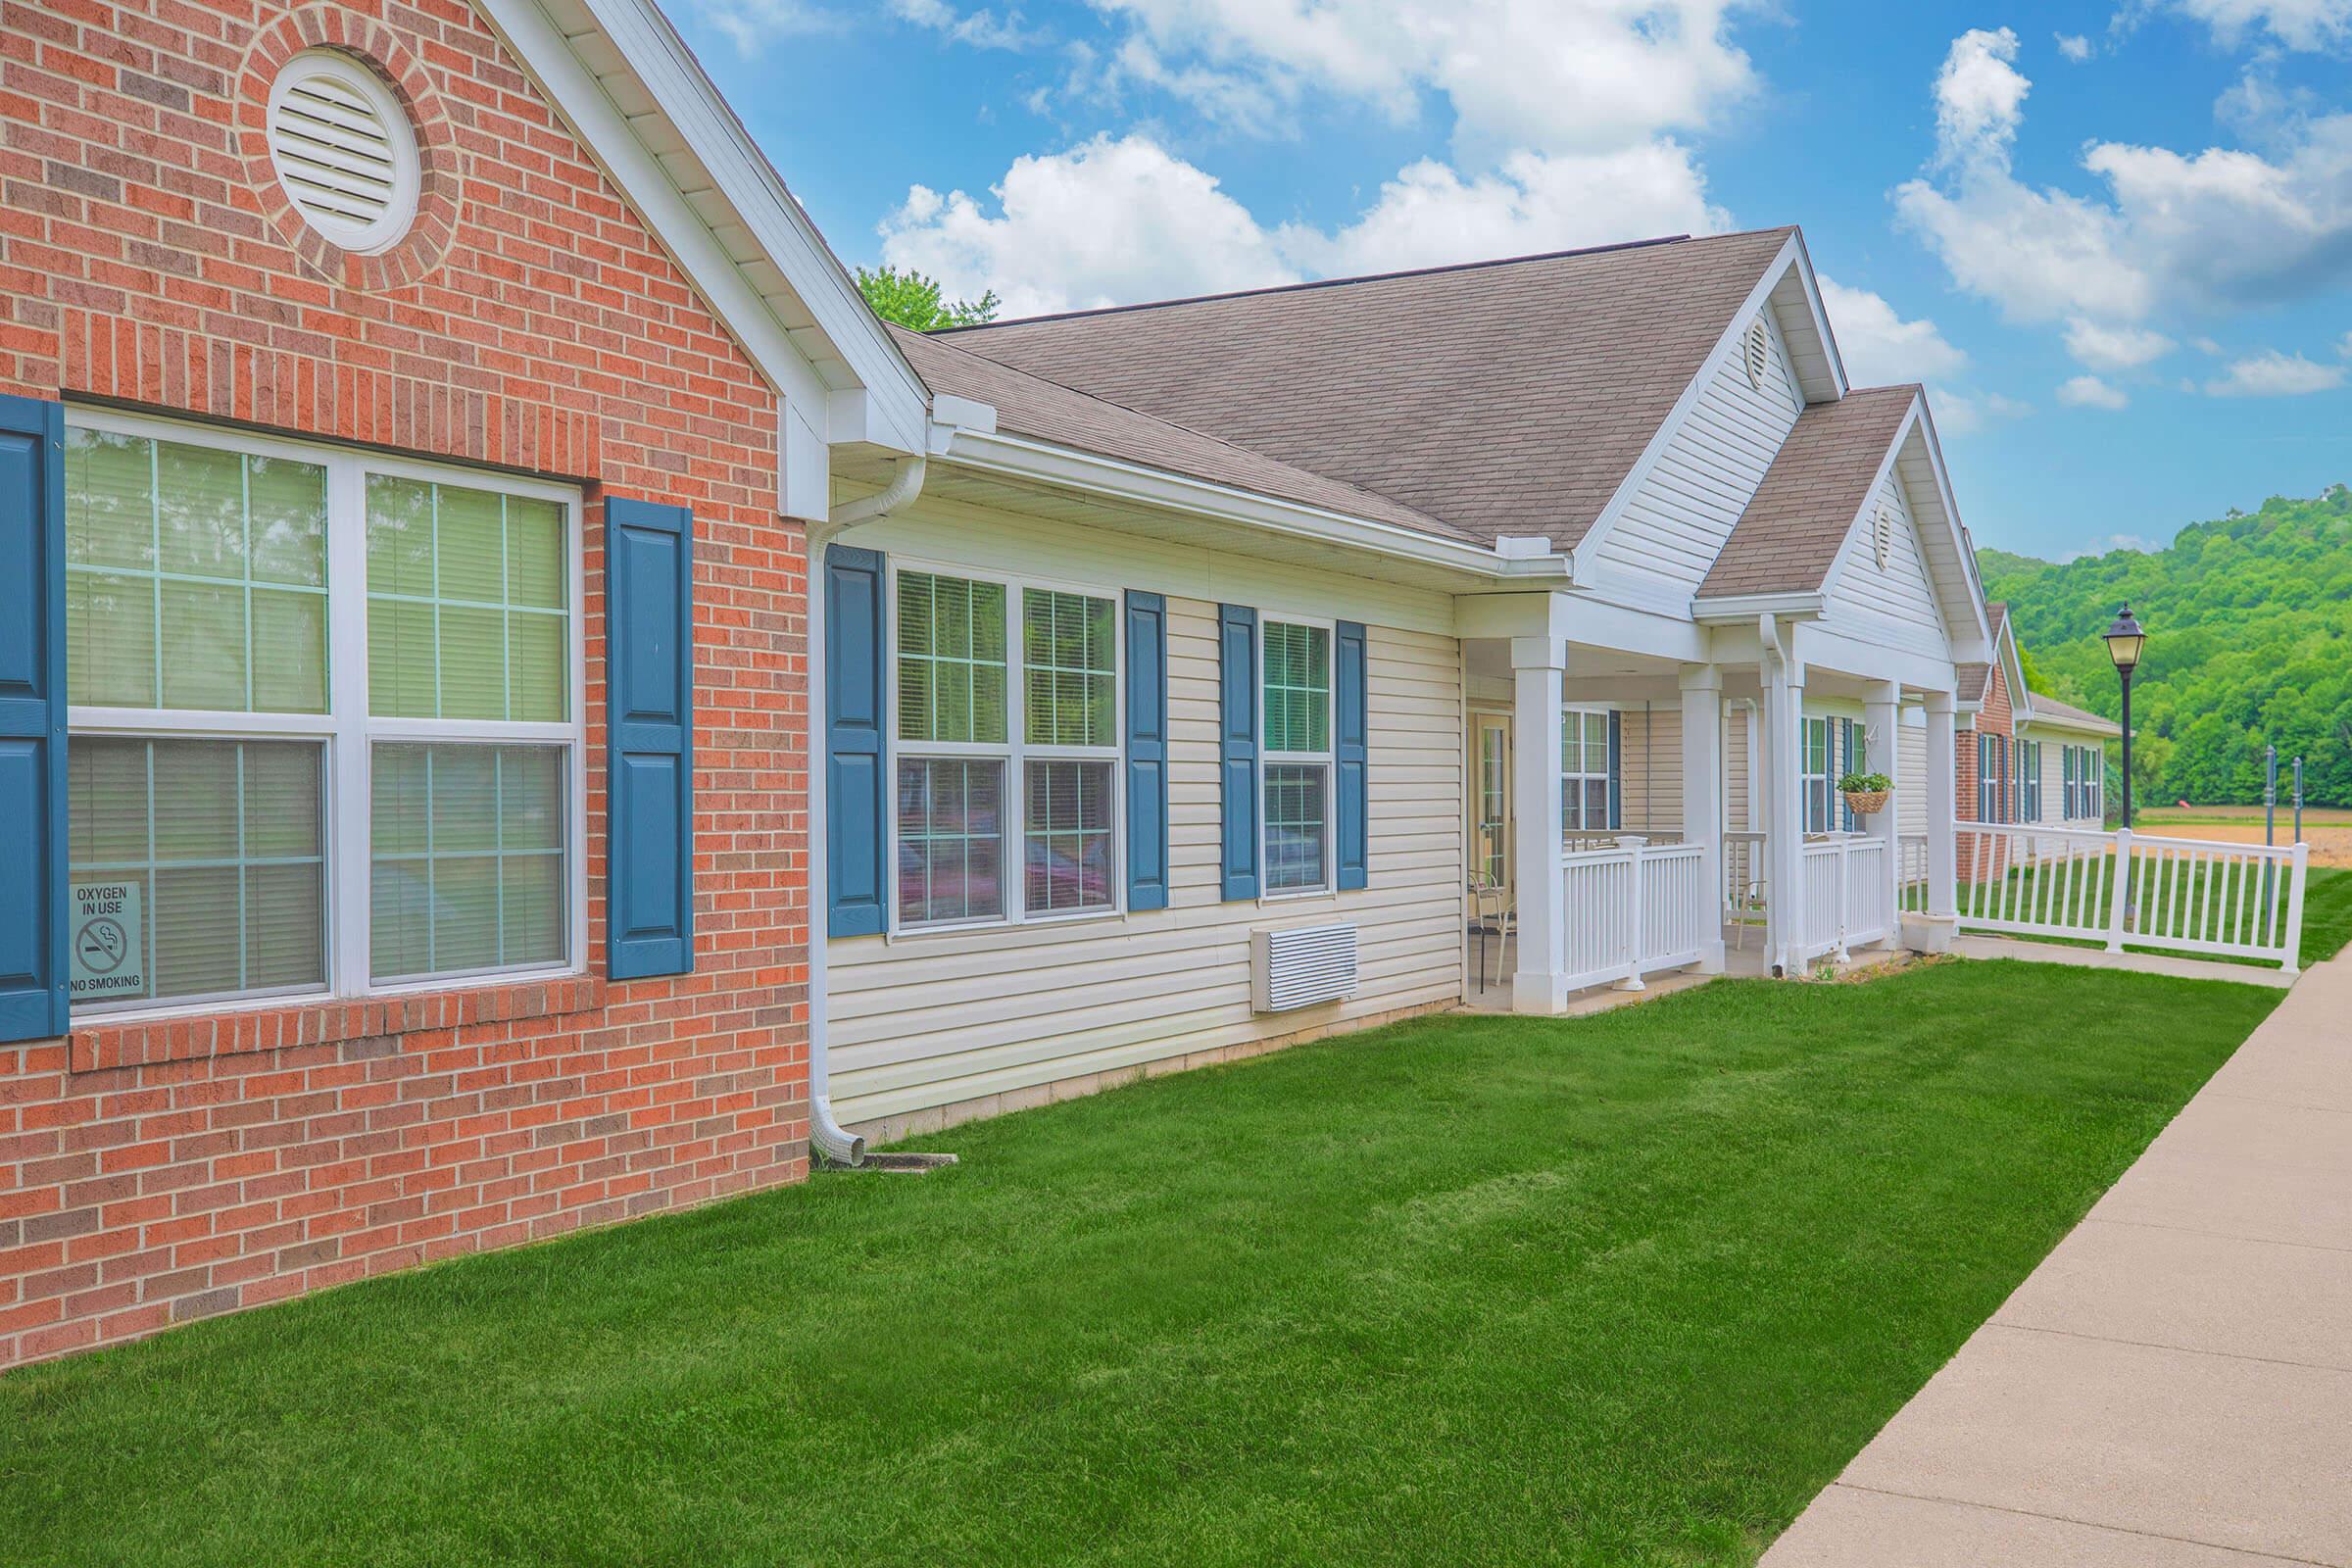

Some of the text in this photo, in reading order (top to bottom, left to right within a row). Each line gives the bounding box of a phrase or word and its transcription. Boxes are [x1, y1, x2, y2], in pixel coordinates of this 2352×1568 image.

[77, 887, 126, 901] OXYGEN
[83, 902, 122, 915] IN USE
[70, 975, 140, 992] NO SMOKING
